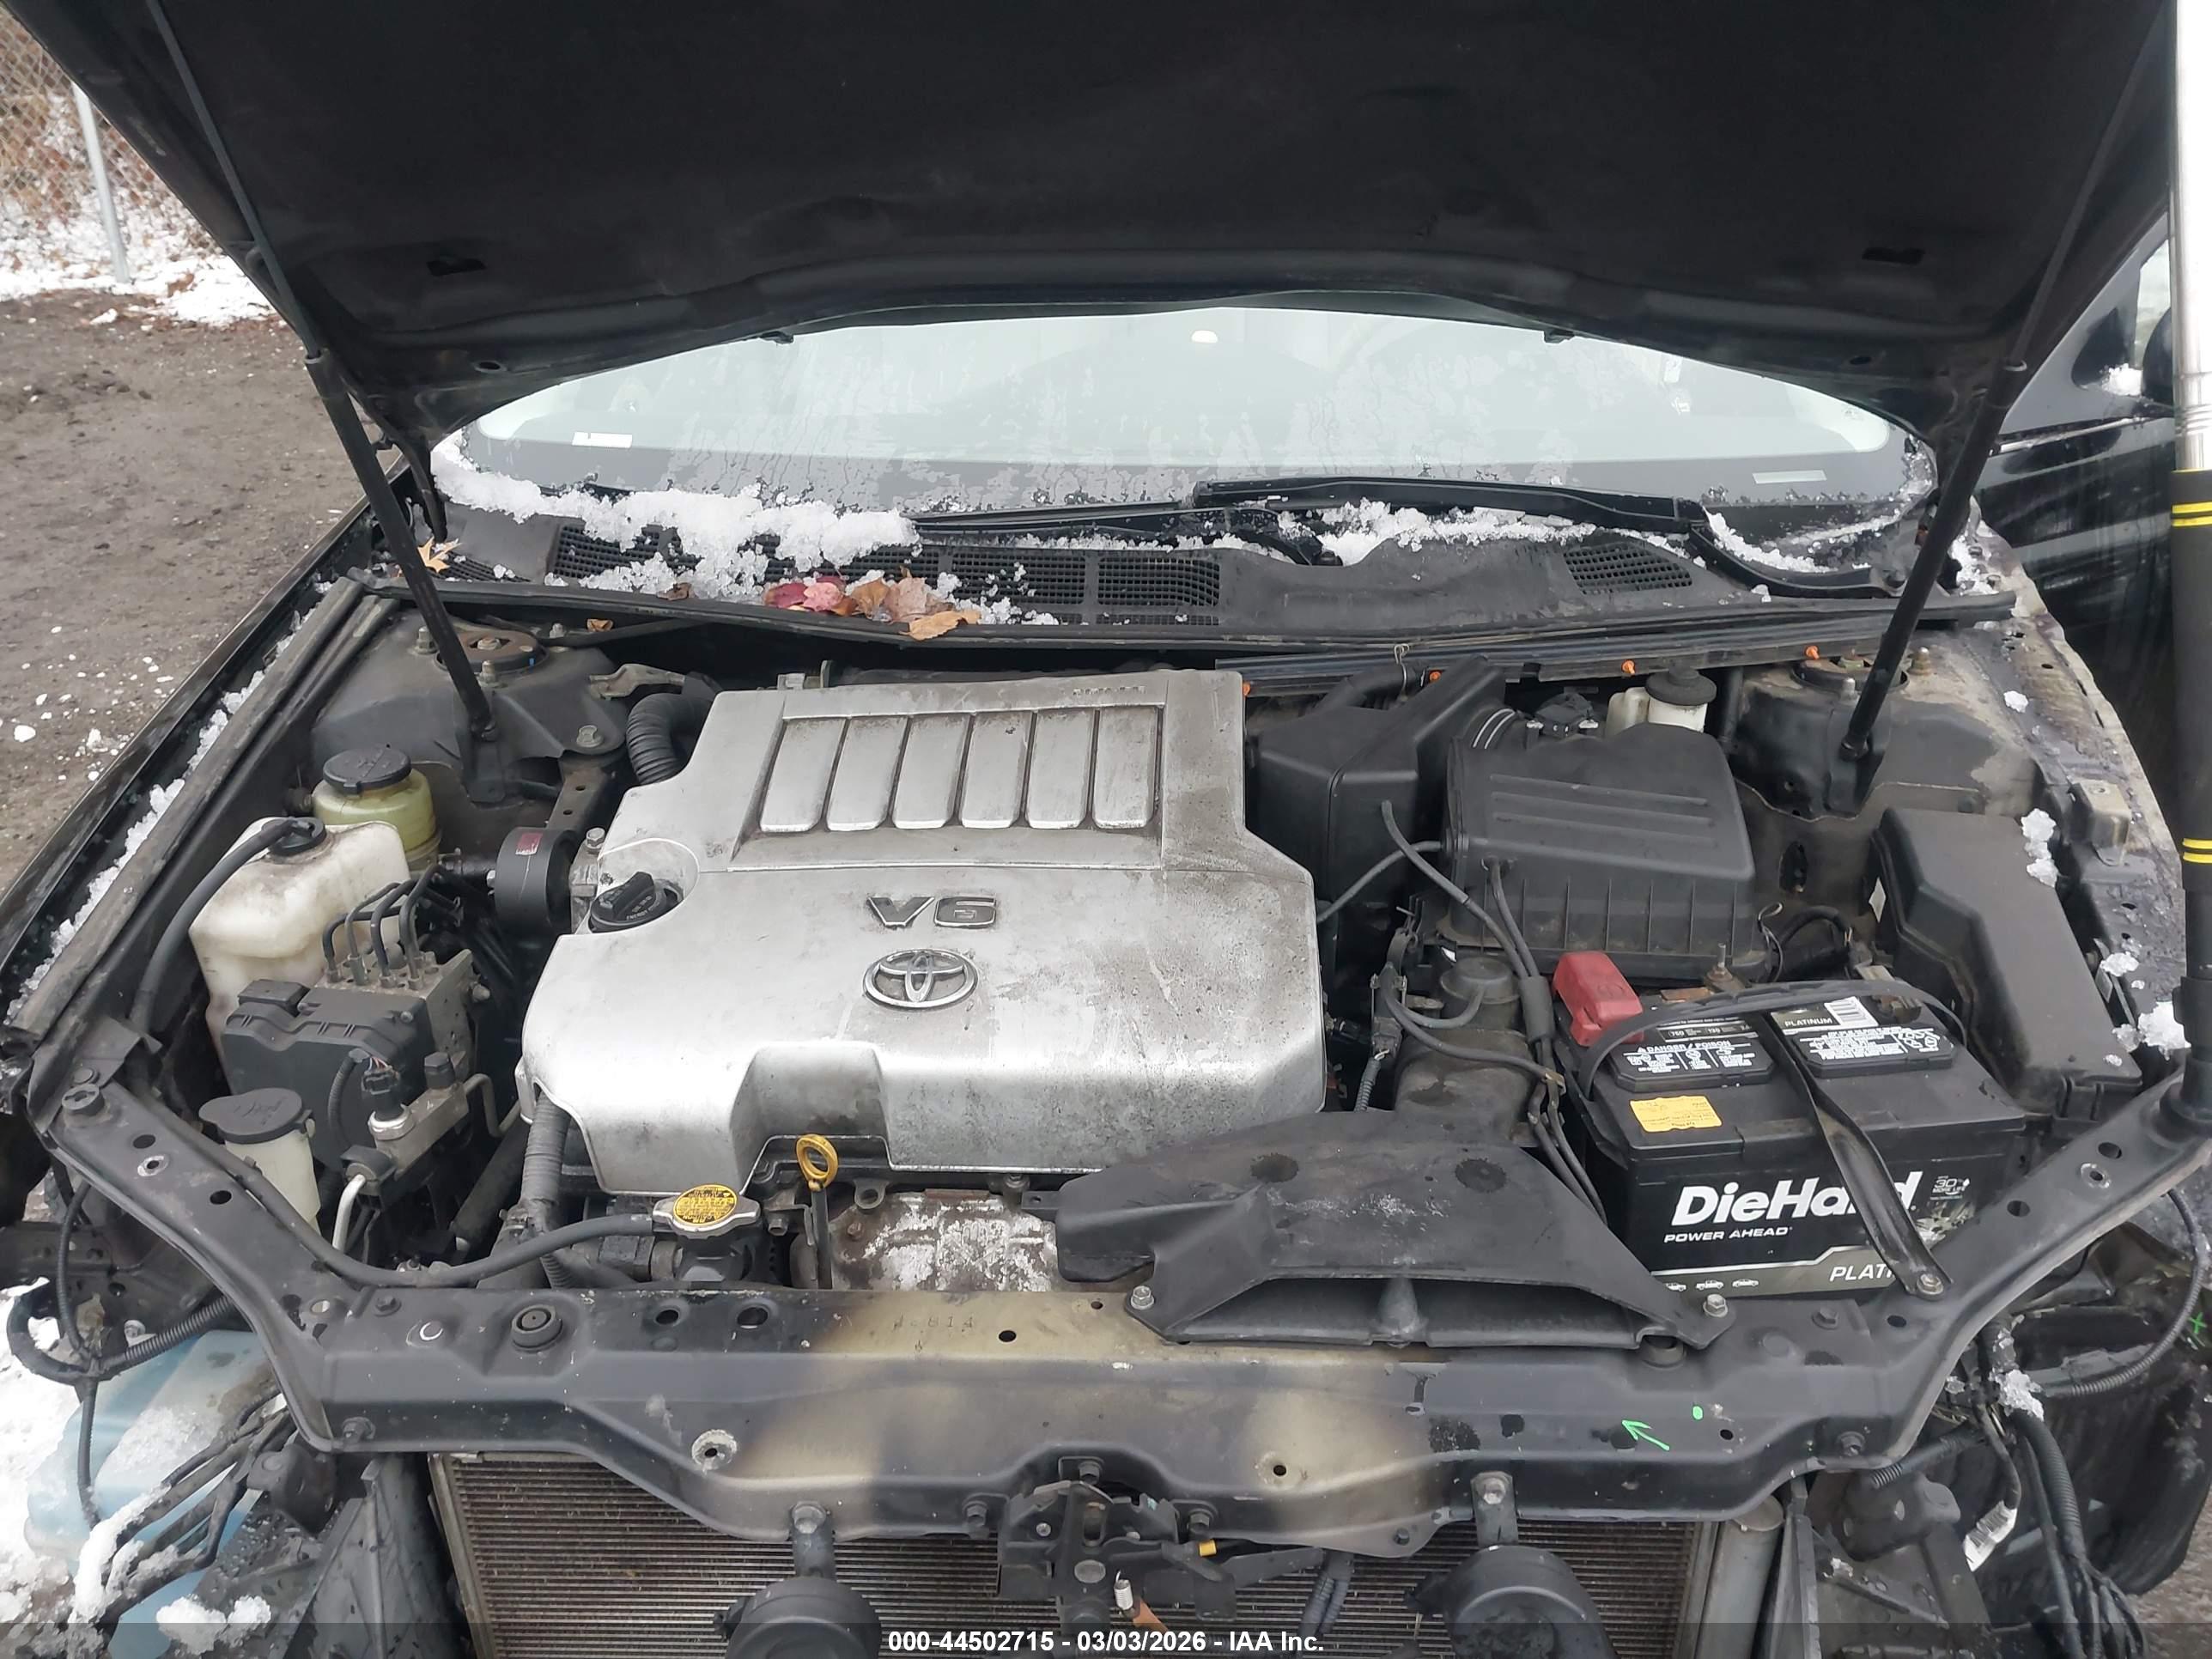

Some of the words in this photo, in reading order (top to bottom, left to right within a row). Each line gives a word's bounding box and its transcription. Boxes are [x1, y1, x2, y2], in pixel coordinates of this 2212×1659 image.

[866, 896, 996, 928] V6
[1784, 1018, 1833, 1027] PLATINUM
[1694, 1039, 1731, 1049] POISON
[1672, 1171, 1923, 1225] DieHad
[1663, 1231, 1725, 1243] POWER
[1729, 1226, 1789, 1239] AHEAD
